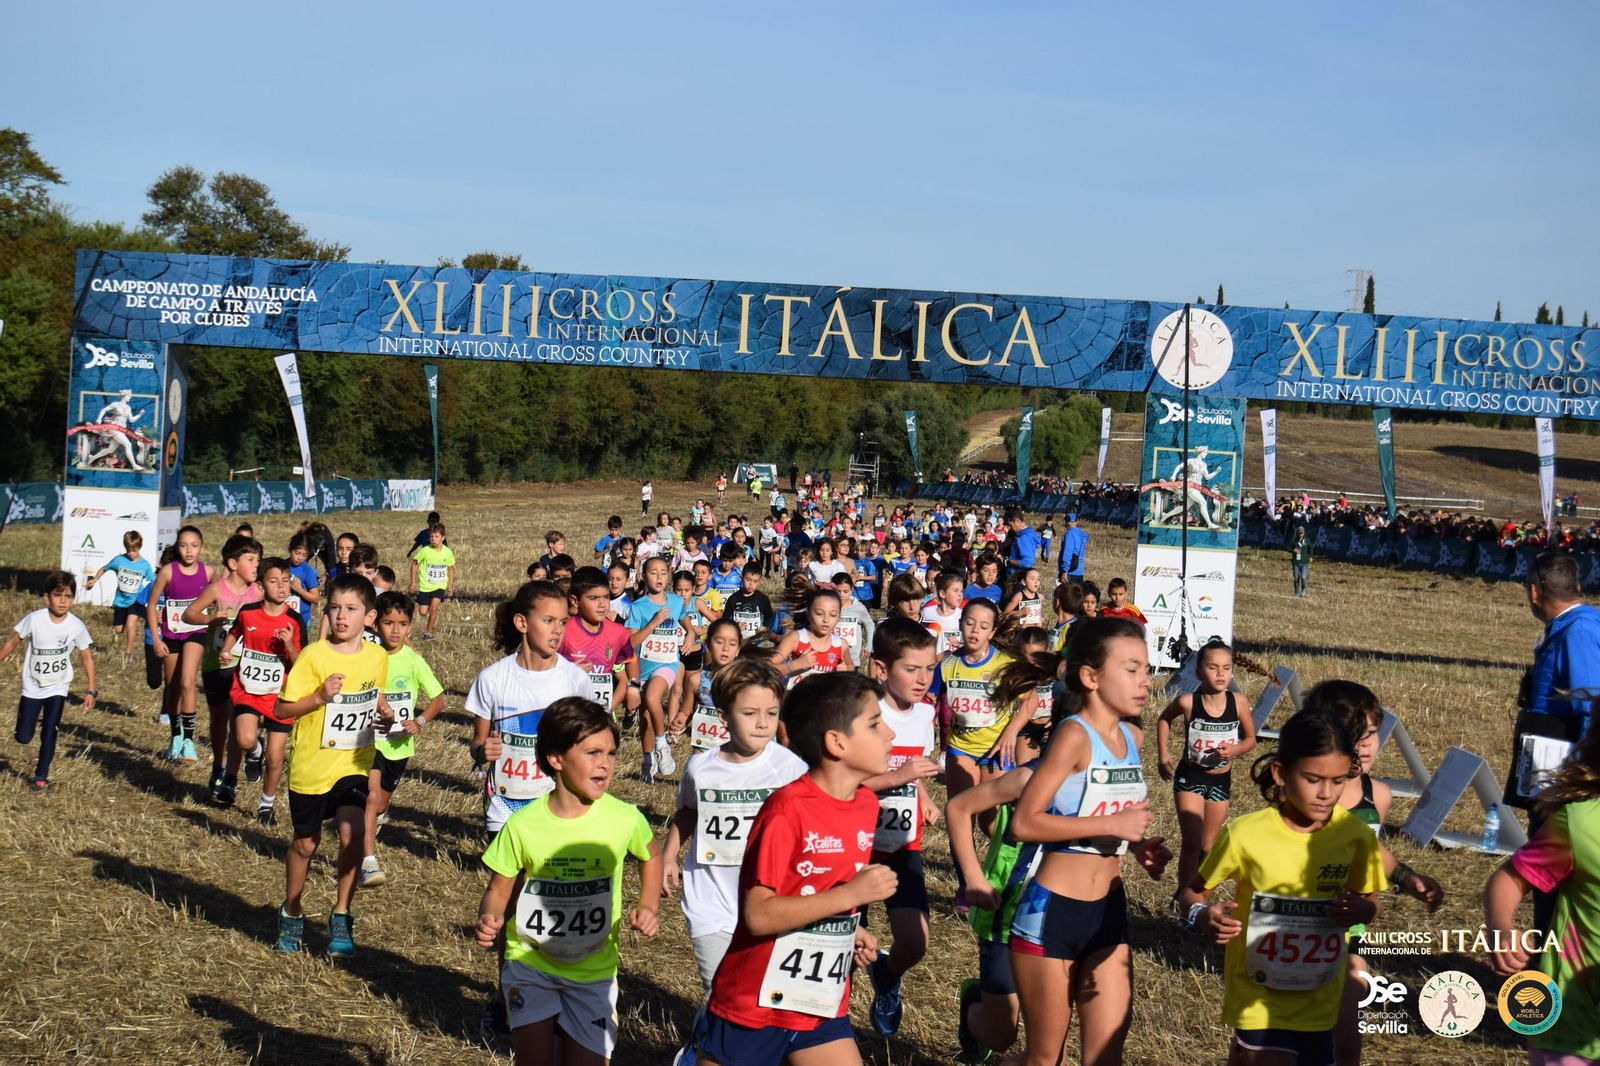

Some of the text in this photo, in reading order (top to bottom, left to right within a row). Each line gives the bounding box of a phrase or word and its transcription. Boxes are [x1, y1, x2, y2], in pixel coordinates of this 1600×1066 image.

[91, 279, 317, 302] CAMPEONATO DE ANDALUCÍA
[125, 295, 282, 315] DE CAMPO A TRAVÉS
[380, 279, 677, 339] XLIII CROSS
[160, 311, 250, 327] POR CLUBES
[735, 286, 1050, 369] ITÁLICA
[547, 324, 723, 347] INTERNACIONAL
[120, 351, 155, 360] Diputación
[379, 337, 691, 366] INTERNATIONAL CROSS COUNTRY
[1280, 322, 1586, 386] XLIII CROSS
[120, 358, 155, 370] Sevilla
[1276, 380, 1598, 417] INTERNATIONAL CROSS COUNTRY
[1197, 406, 1232, 415] Diputación
[1197, 414, 1232, 426] Sevilla
[118, 575, 140, 587] 4297
[428, 570, 446, 579] 4135
[832, 627, 855, 638] 354
[645, 640, 676, 653] 4352
[34, 658, 68, 675] 4268
[242, 665, 281, 683] 4256
[951, 697, 993, 714] 4345
[330, 709, 374, 732] 4275
[697, 722, 730, 740] 442
[501, 757, 549, 781] 441
[721, 790, 762, 801] ITÁLICA
[815, 836, 843, 849] califas
[546, 883, 590, 895] ITÁLICA
[525, 906, 606, 937] 4249
[1256, 931, 1341, 964] 4529
